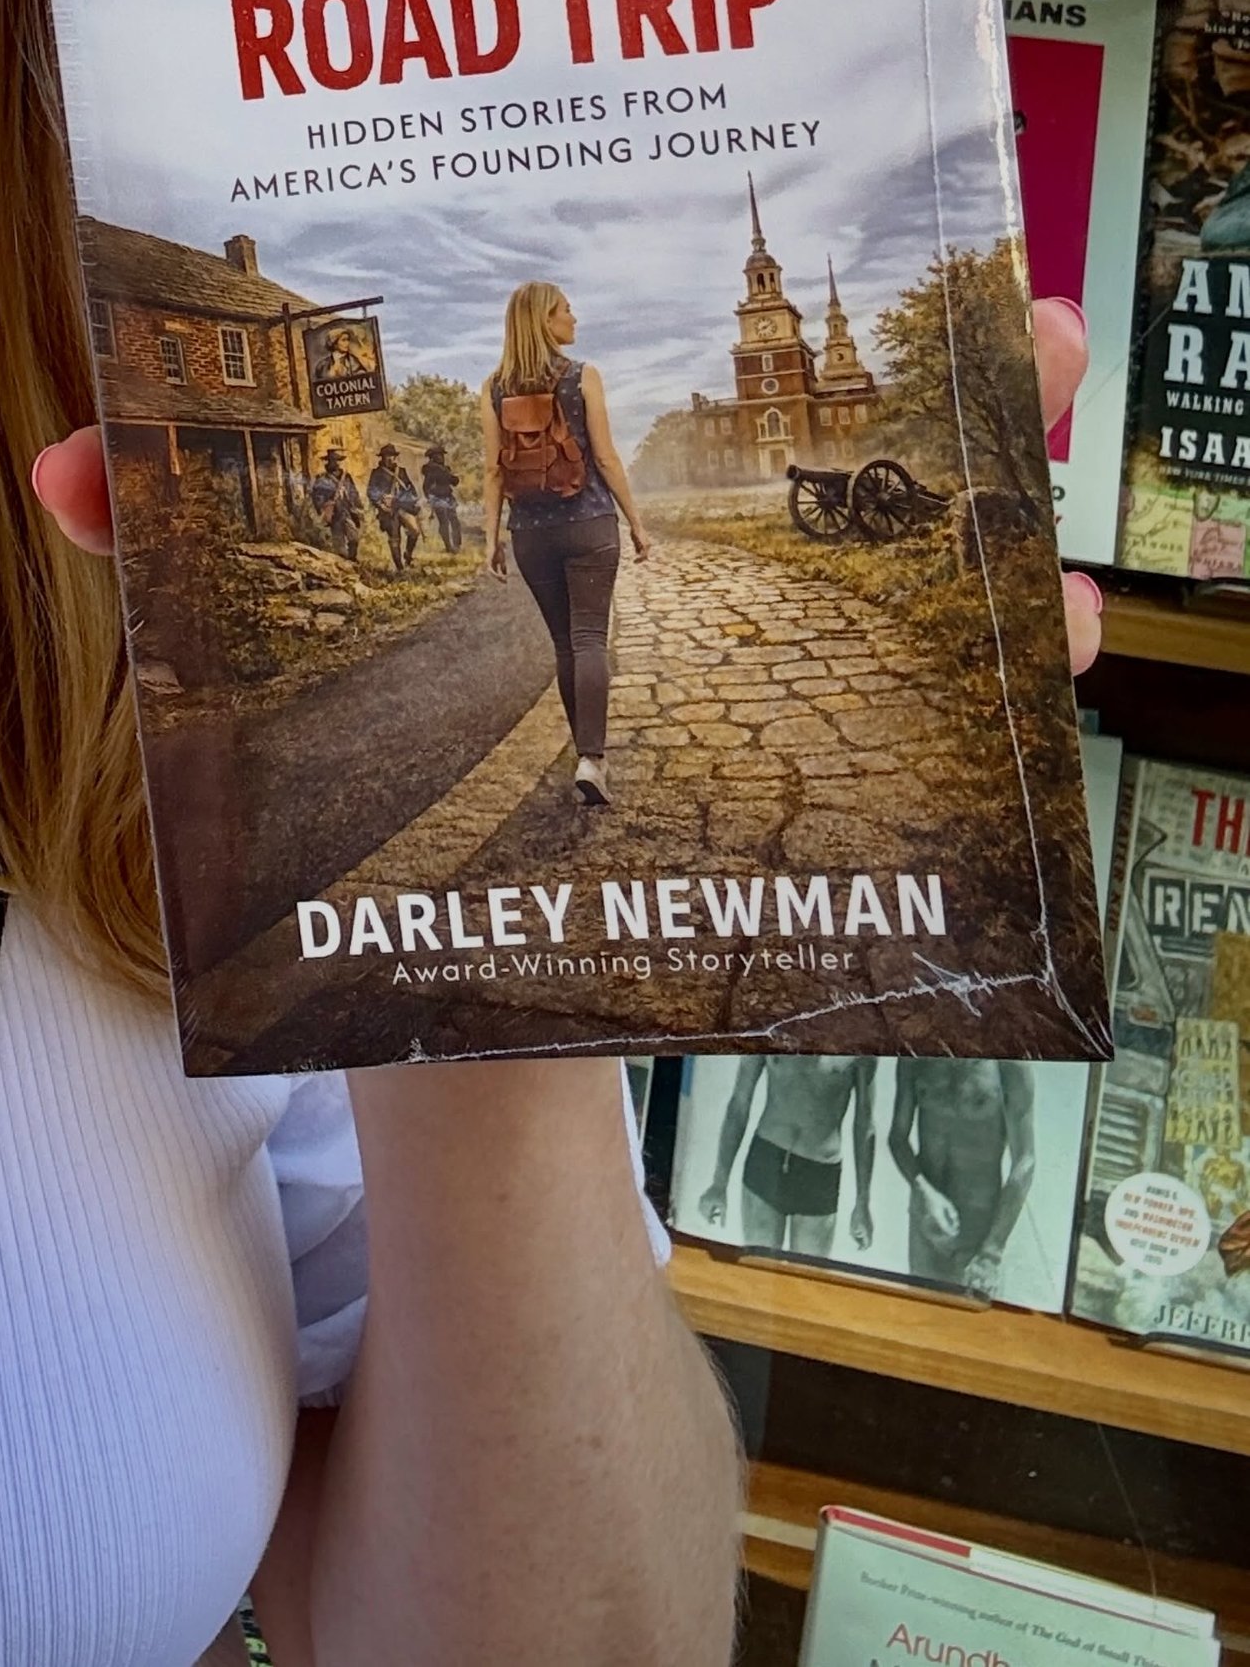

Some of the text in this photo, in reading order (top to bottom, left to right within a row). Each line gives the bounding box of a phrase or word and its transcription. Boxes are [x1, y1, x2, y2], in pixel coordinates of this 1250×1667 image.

[307, 83, 728, 150] HIDDEN STORIES FROM
[230, 120, 822, 202] AMERICA'S FOUNDING JOURNEY
[316, 377, 376, 397] COLONIAL
[326, 392, 371, 410] TAVERN
[1166, 389, 1245, 416] WALKING
[296, 874, 947, 959] DARLEY NEWMAN
[392, 944, 855, 985] Award-Winning Storyteller
